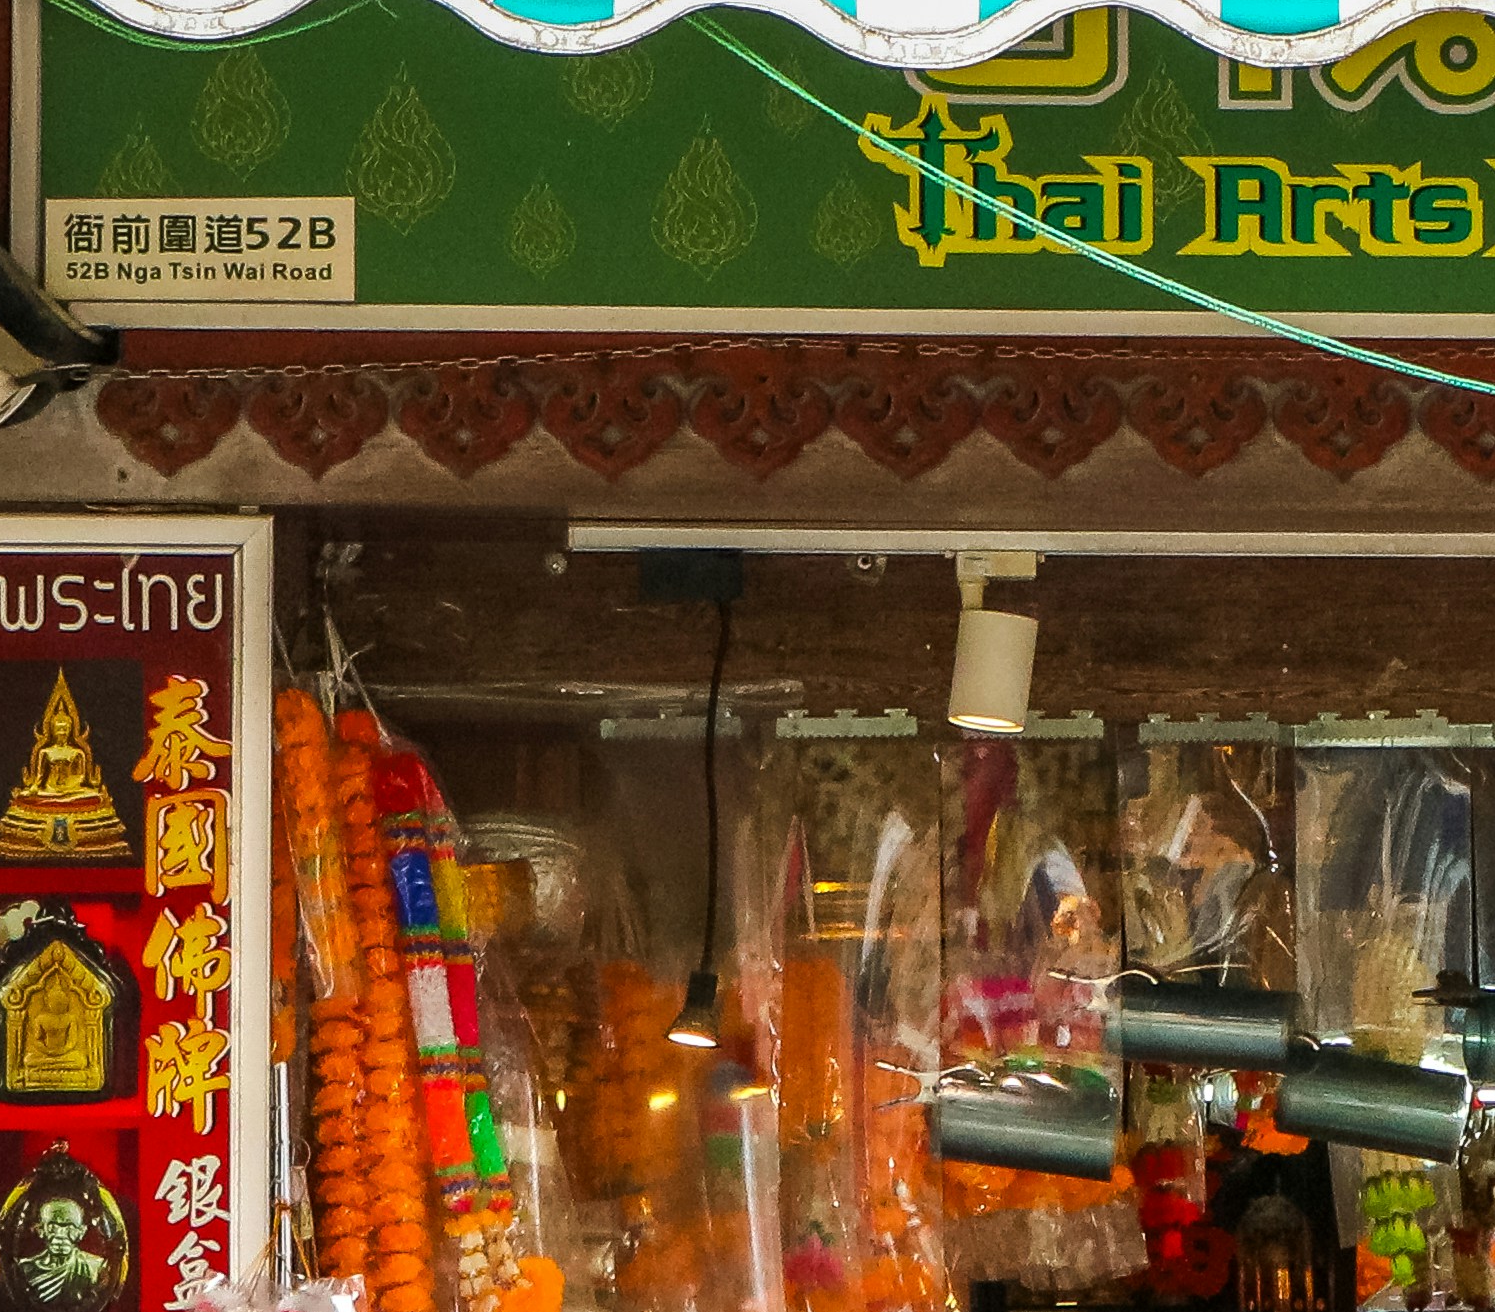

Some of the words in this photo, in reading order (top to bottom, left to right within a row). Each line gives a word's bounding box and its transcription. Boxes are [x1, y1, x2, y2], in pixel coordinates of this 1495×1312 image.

[862, 97, 1152, 264] Thai
[1204, 155, 1484, 257] Arts
[64, 214, 337, 254] 衙前圍道52B
[66, 263, 111, 281] 52B
[117, 263, 162, 285] Nga
[168, 262, 216, 281] Tsin
[223, 262, 265, 281] Wai
[273, 263, 333, 281] Road
[133, 672, 233, 1135] 泰國佛牌
